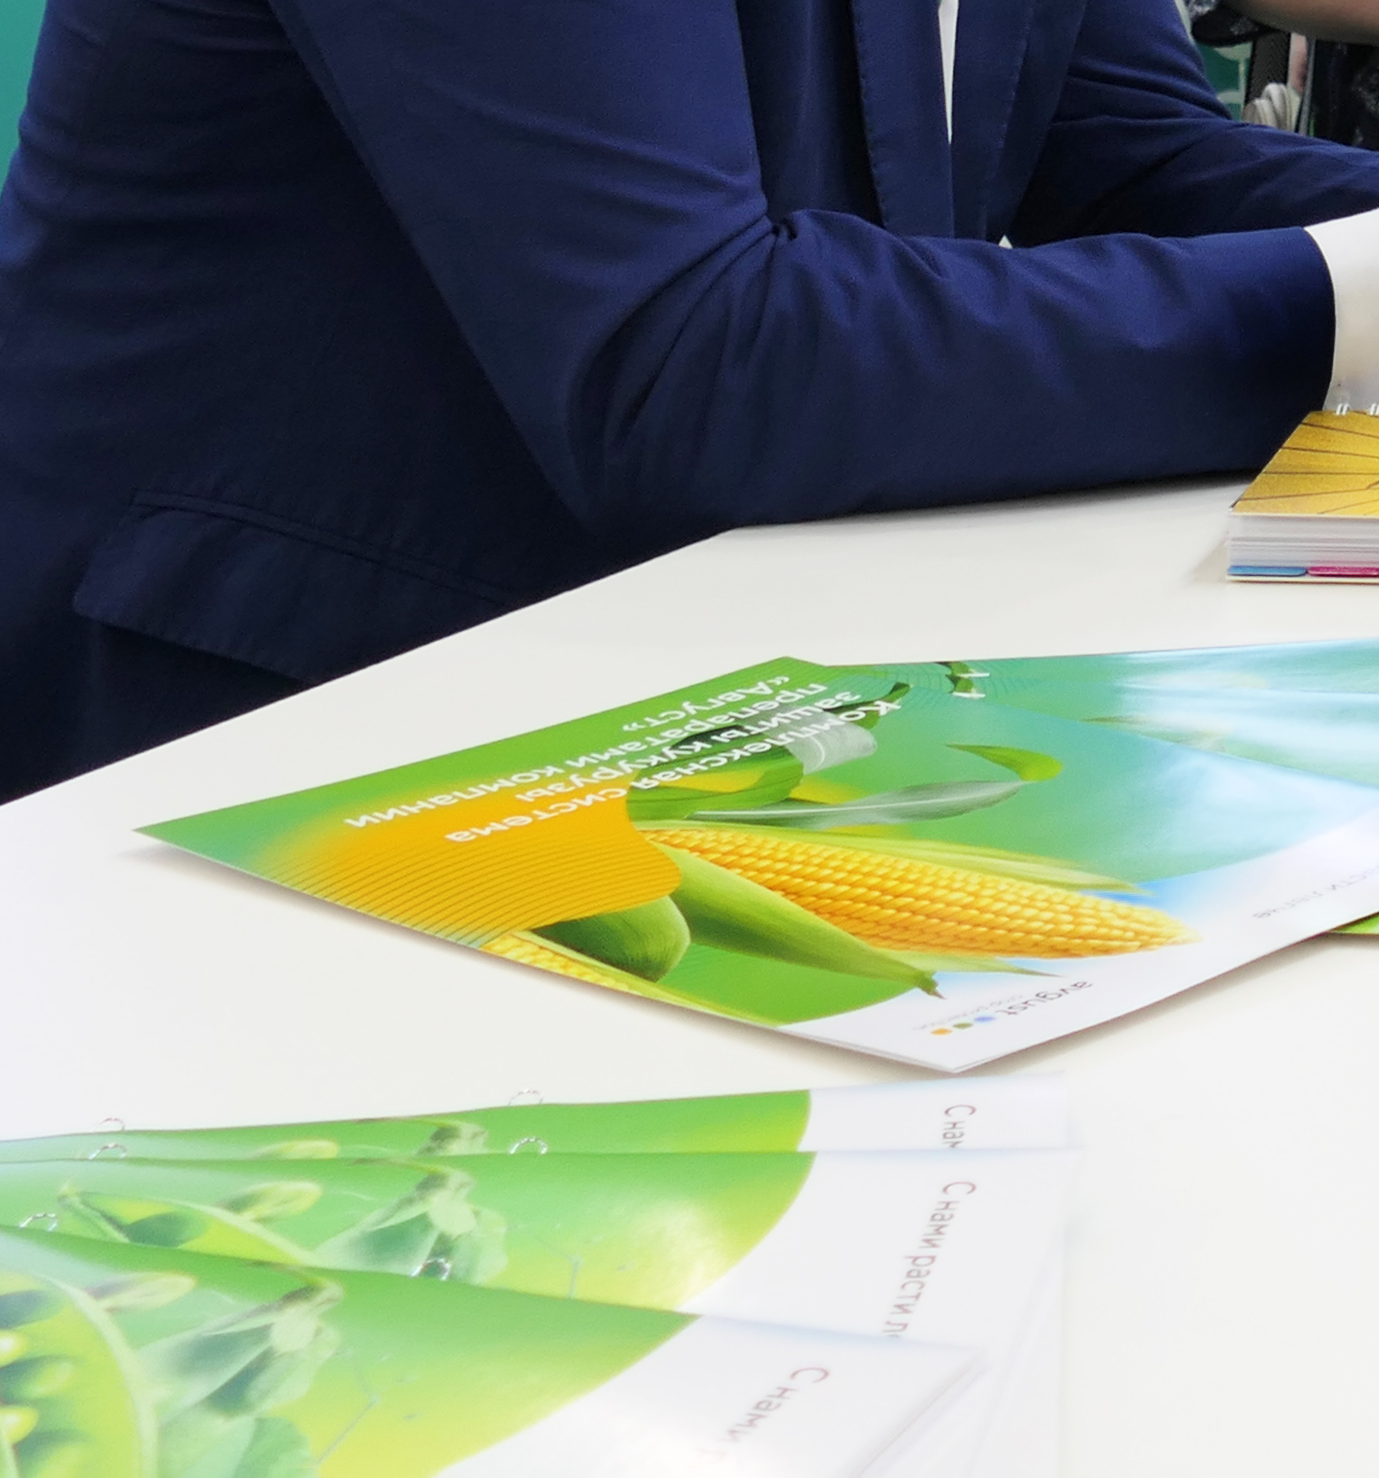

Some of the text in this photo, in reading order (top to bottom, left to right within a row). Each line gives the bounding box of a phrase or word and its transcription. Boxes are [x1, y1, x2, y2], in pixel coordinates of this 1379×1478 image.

[622, 675, 792, 733] «Август»
[345, 683, 828, 829] препаратами компании
[444, 699, 902, 844] Комплексная система
[516, 691, 862, 804] защиты кукурузы
[994, 979, 1094, 1017] avgust
[941, 1180, 977, 1196] С
[917, 1199, 960, 1250] нами
[889, 1253, 938, 1317] расти
[789, 1366, 830, 1384] С
